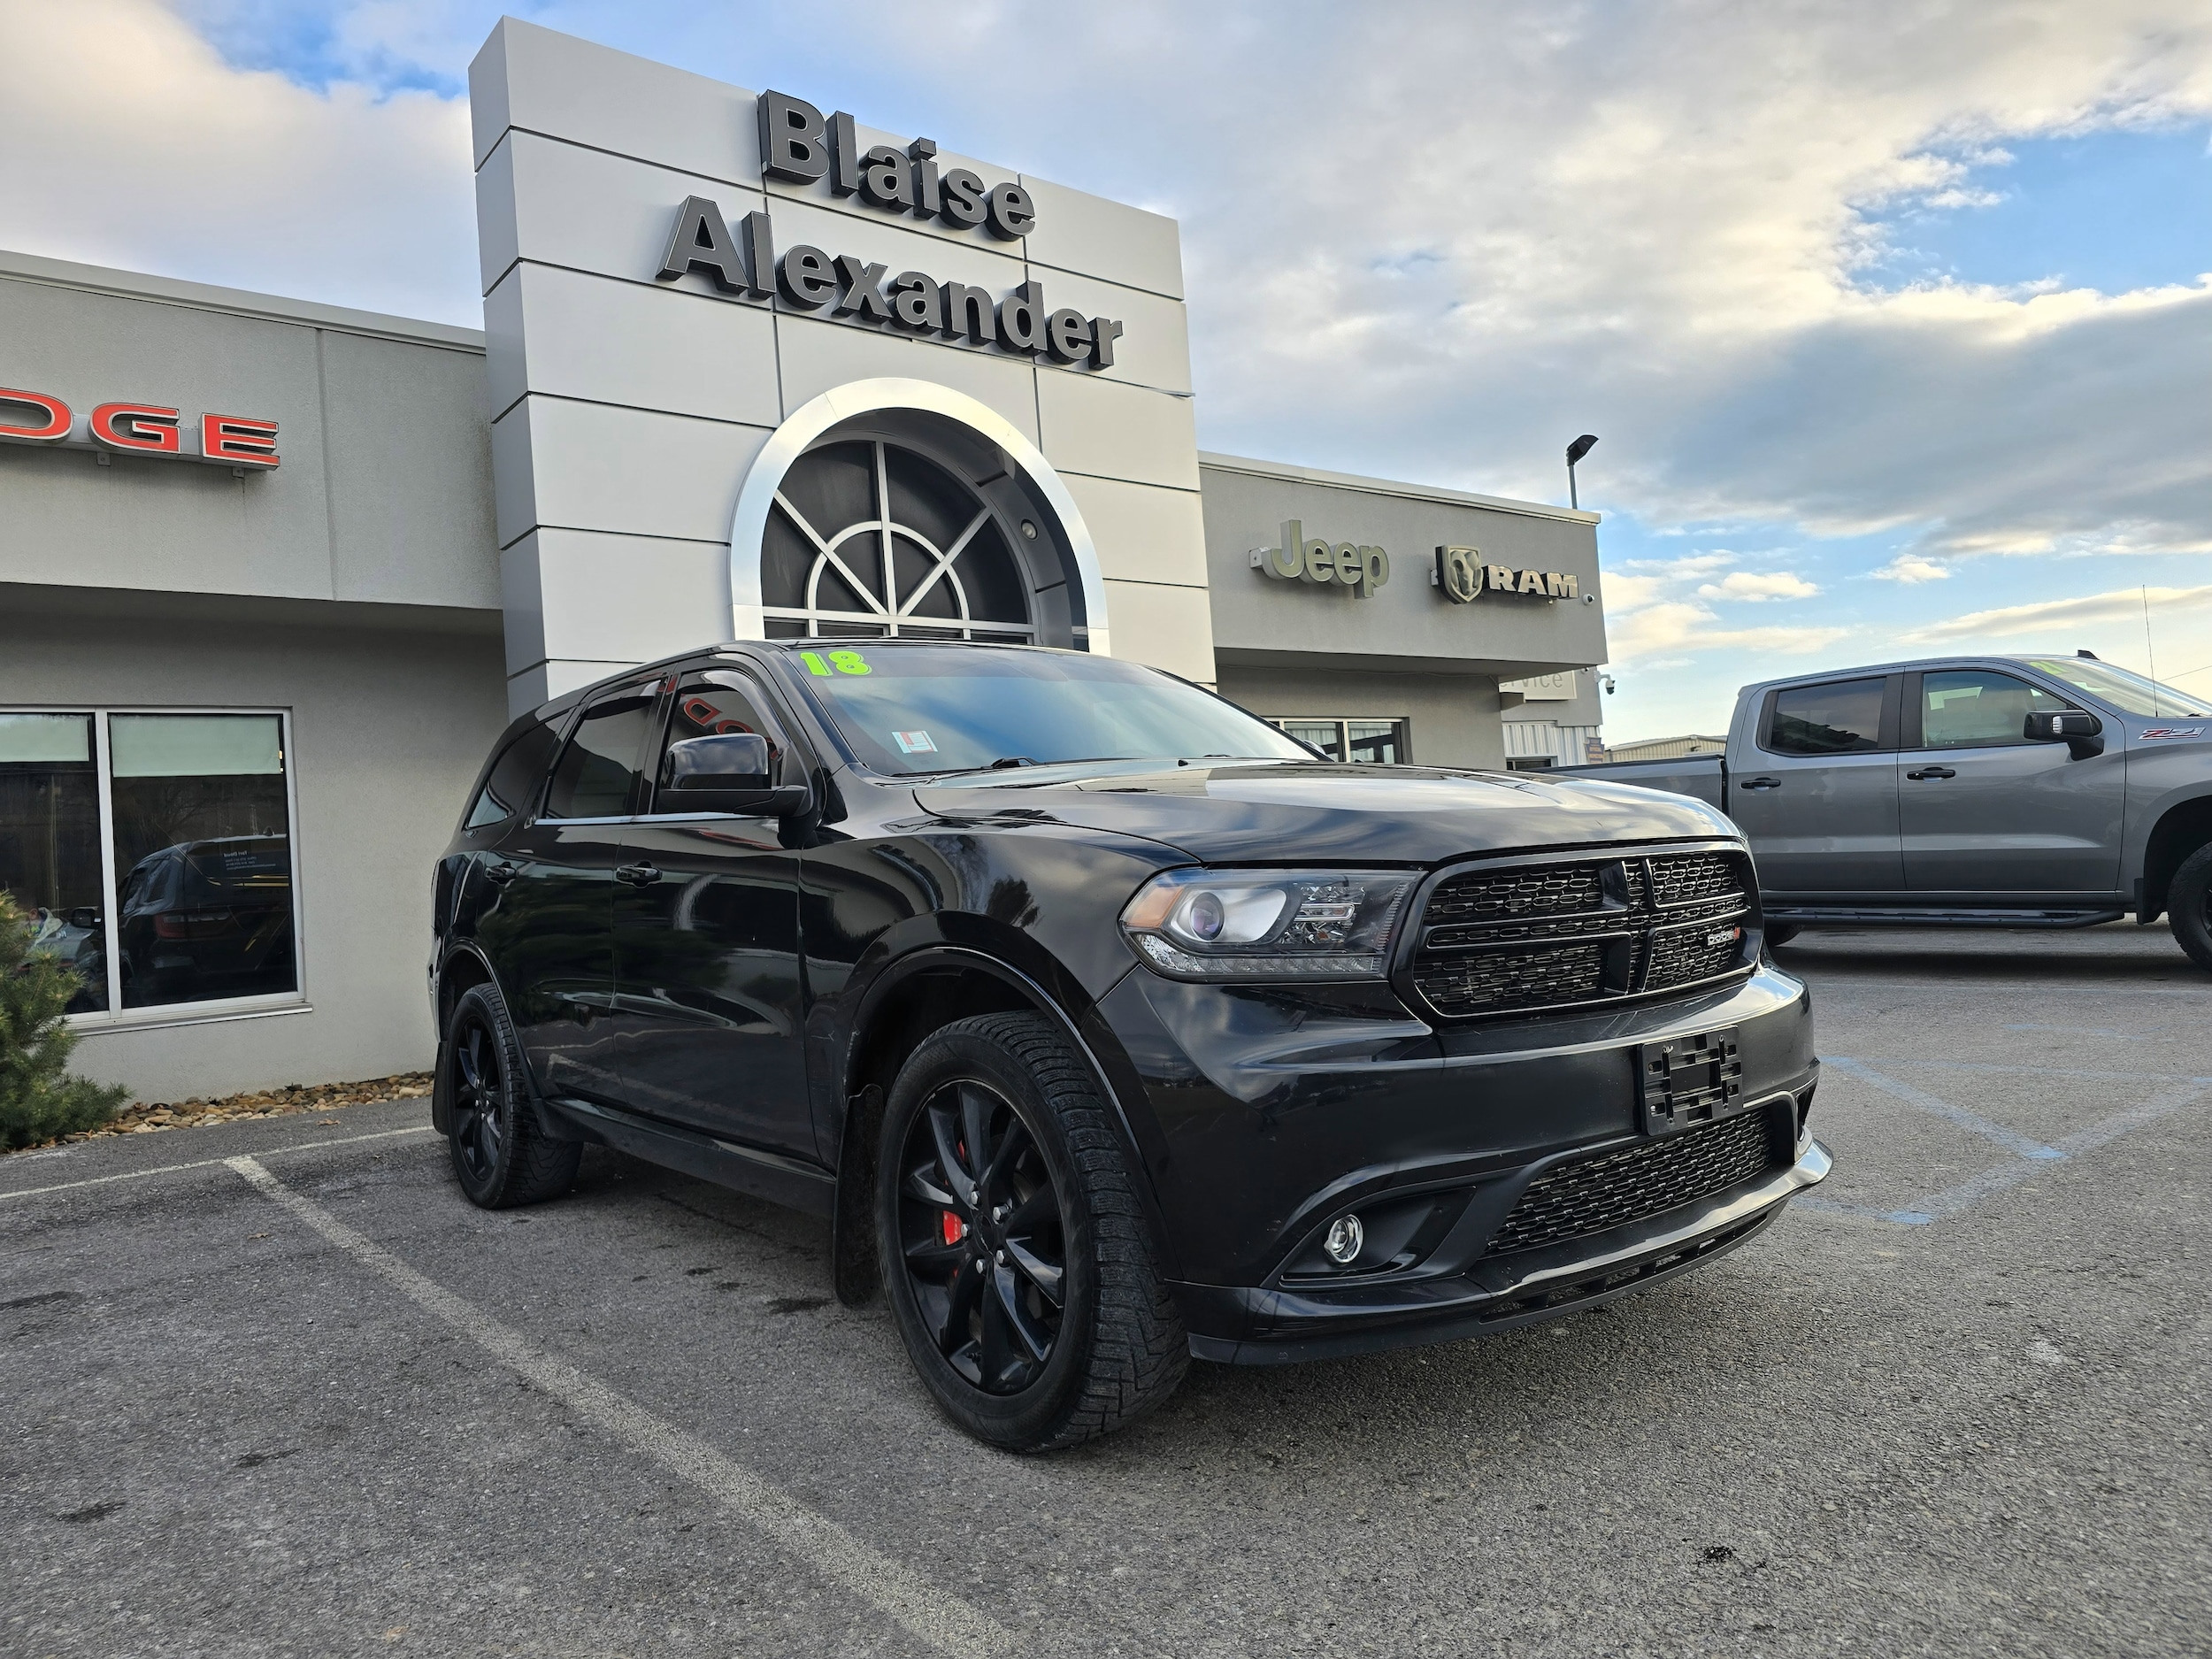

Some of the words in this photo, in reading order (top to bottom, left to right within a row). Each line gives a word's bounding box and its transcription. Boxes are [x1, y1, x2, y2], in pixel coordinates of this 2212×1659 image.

[758, 88, 1035, 242] Blaise
[656, 195, 1124, 371] Alexander
[1262, 519, 1389, 599] Jeep
[1484, 565, 1579, 599] RAM
[800, 650, 872, 676] 18
